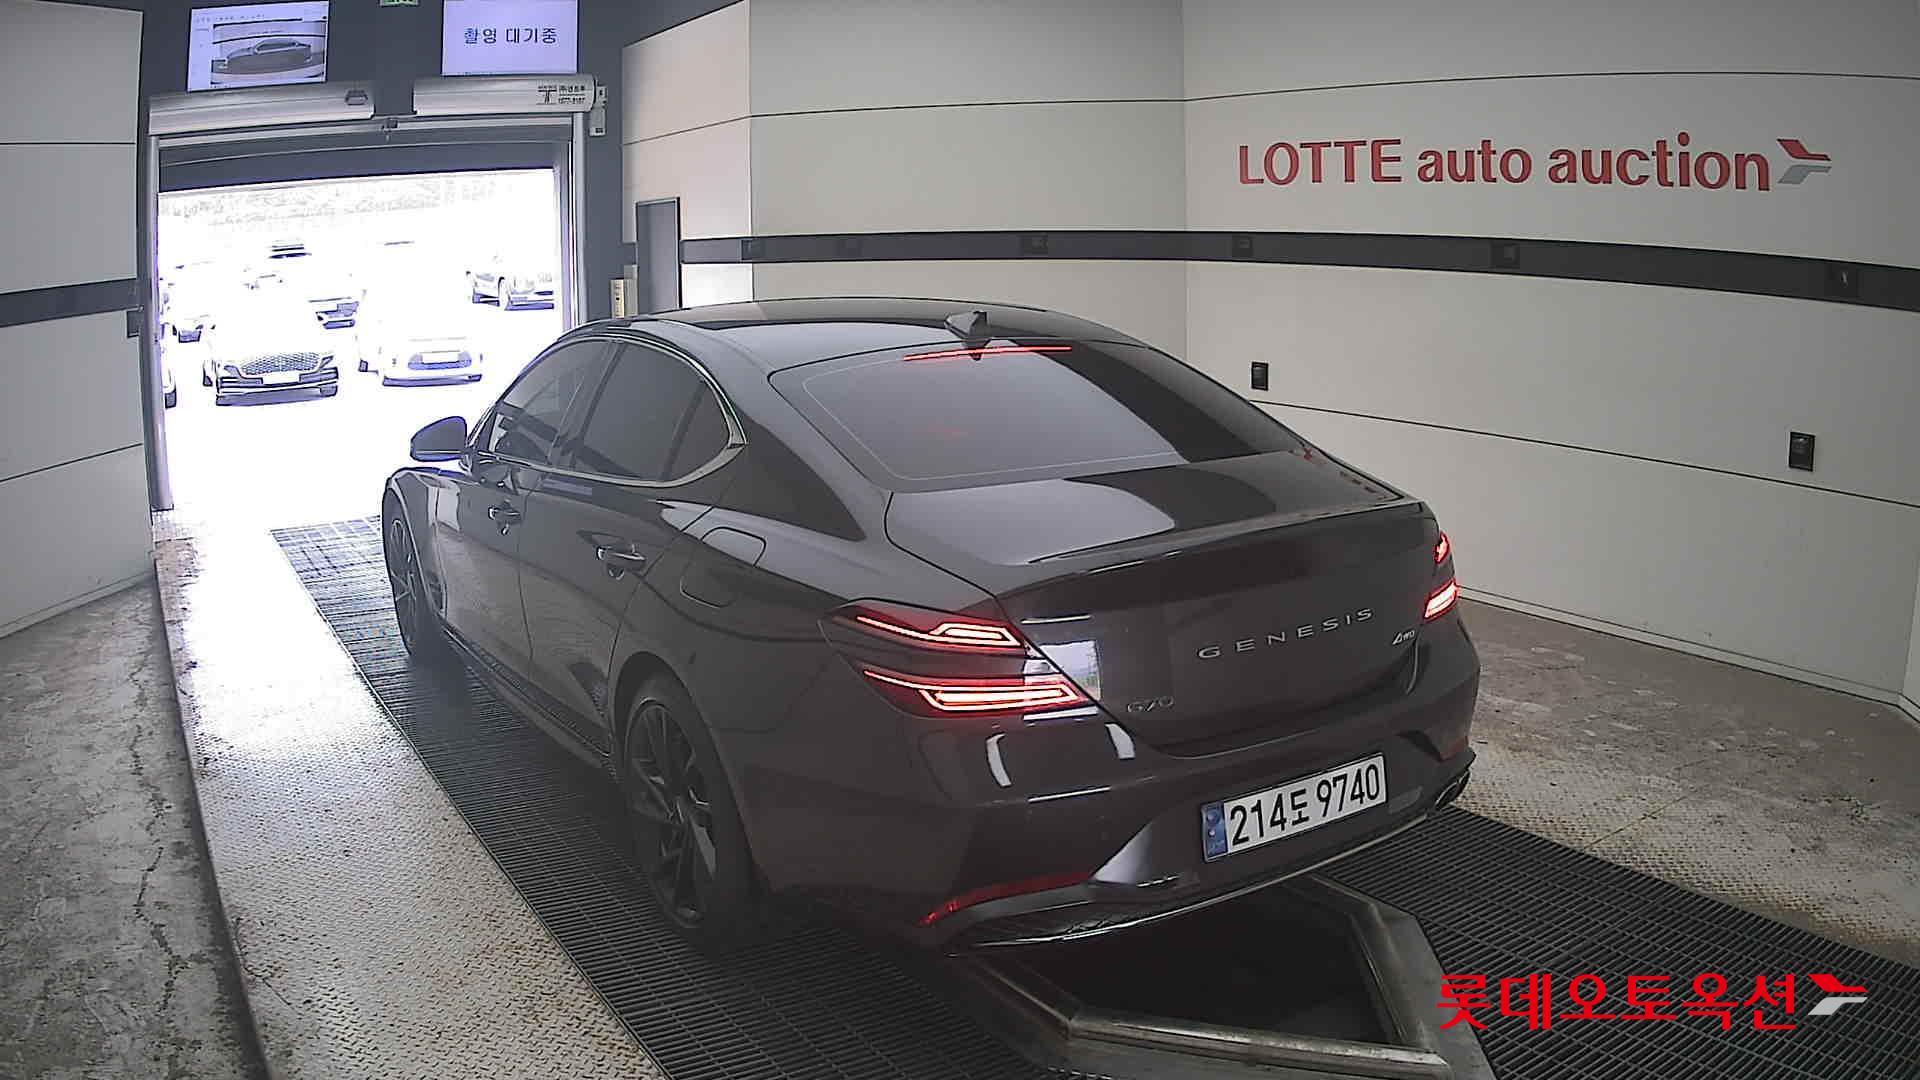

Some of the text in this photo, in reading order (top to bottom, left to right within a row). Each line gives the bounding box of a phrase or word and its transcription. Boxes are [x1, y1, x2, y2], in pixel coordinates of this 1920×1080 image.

[464, 27, 558, 45] 촬영 대기중
[1239, 132, 1770, 191] LOTTE auto auction
[1198, 608, 1374, 659] GENESIS
[1230, 763, 1380, 847] 214도 9740
